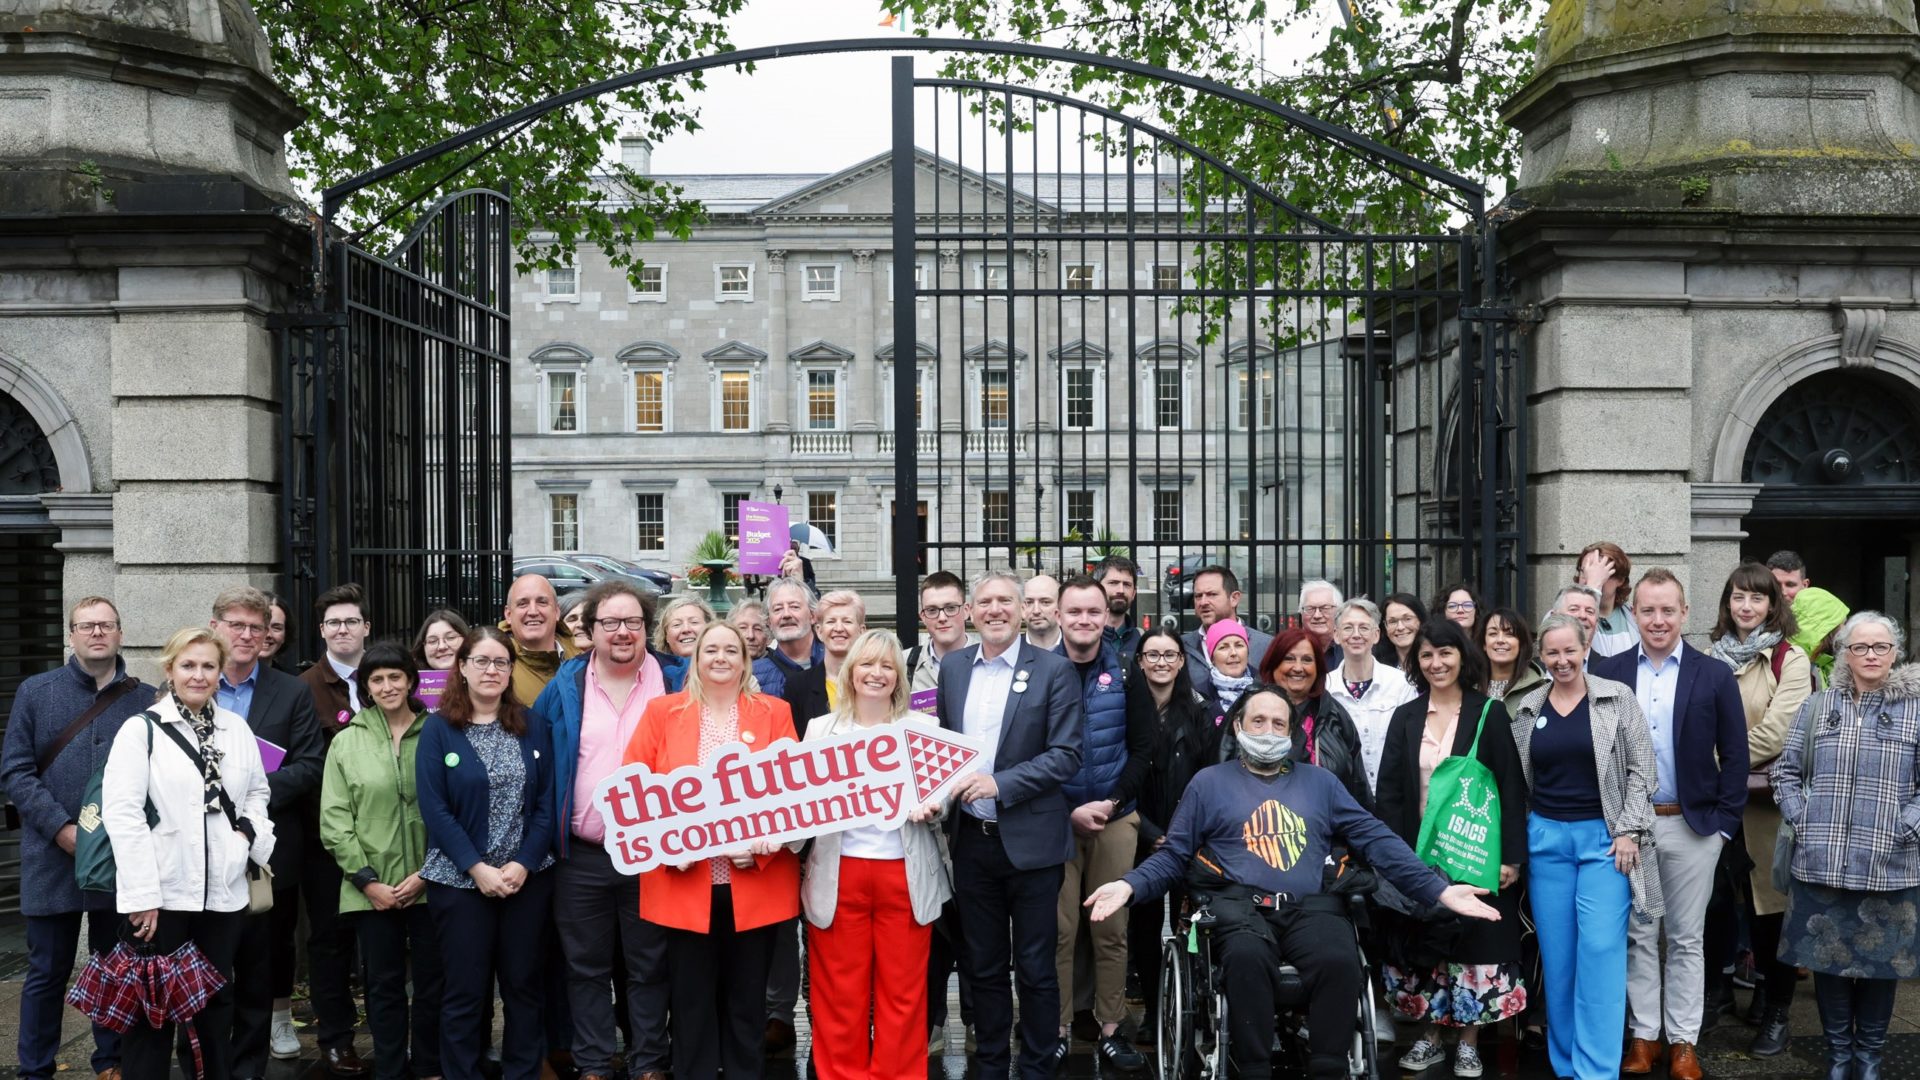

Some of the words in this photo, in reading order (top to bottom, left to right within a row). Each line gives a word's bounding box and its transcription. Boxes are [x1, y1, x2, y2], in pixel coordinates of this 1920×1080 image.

[746, 530, 771, 539] Budget
[604, 771, 707, 827] the
[713, 734, 900, 806] future
[615, 831, 653, 865] is
[660, 782, 905, 856] community
[1242, 800, 1306, 839] AUTISM
[1448, 813, 1488, 844] ISACS
[1245, 832, 1307, 872] ROCKS
